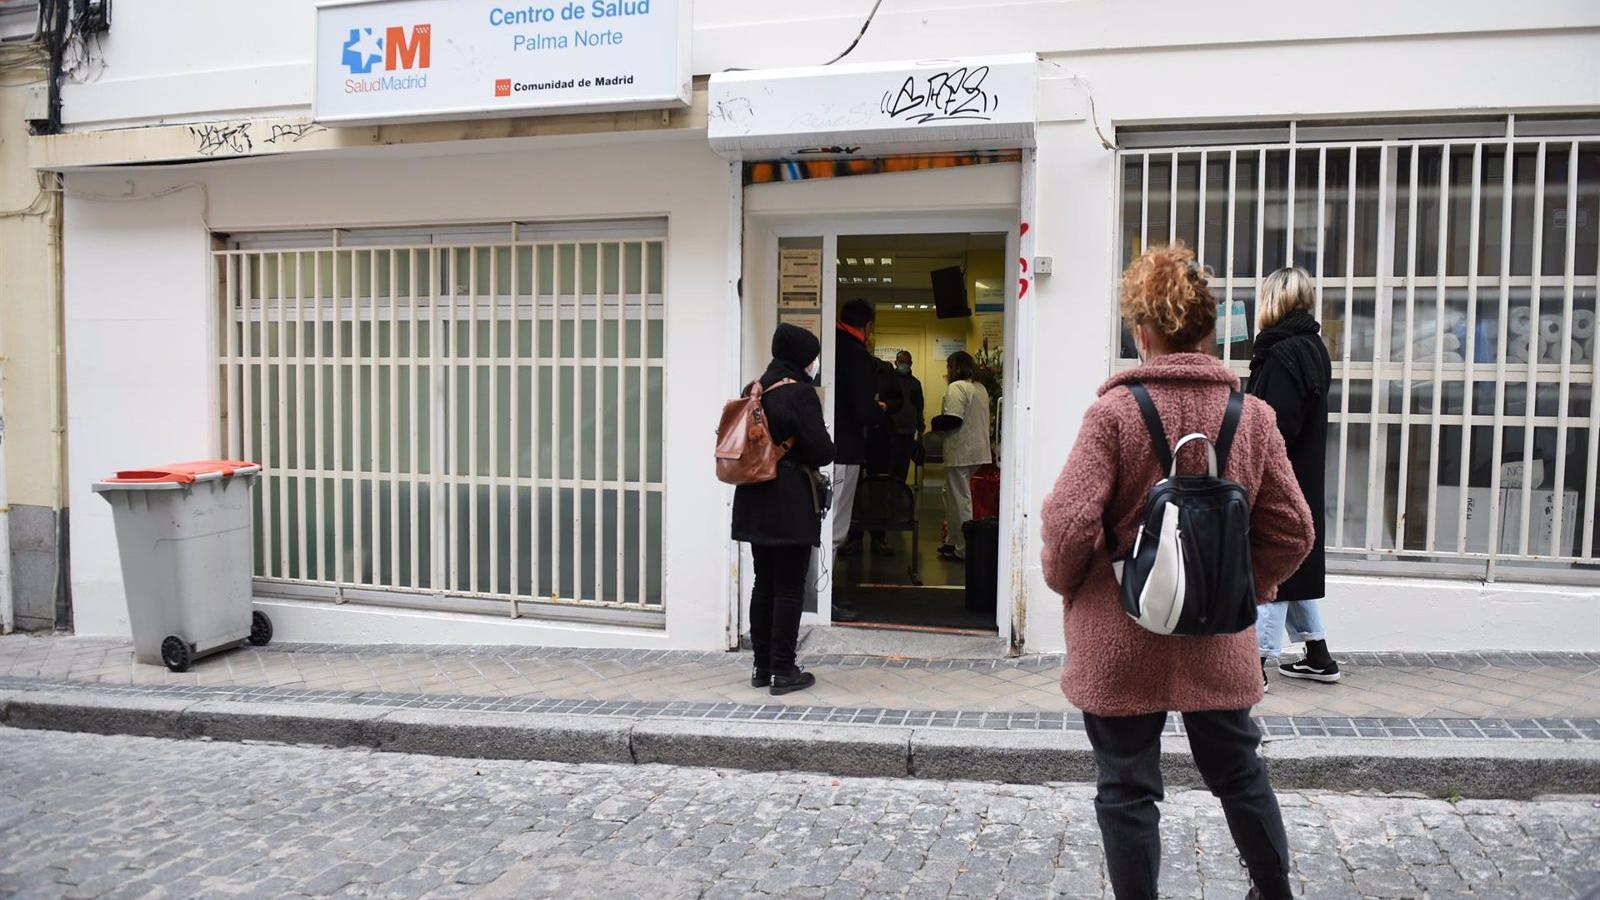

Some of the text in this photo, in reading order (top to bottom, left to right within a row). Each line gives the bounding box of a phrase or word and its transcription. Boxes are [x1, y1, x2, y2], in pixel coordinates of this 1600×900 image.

[489, 0, 650, 26] Centro de Salud
[513, 29, 623, 51] Palma Norte
[344, 74, 427, 94] SaludMadrid
[514, 75, 634, 92] Comunidad de Madrid
